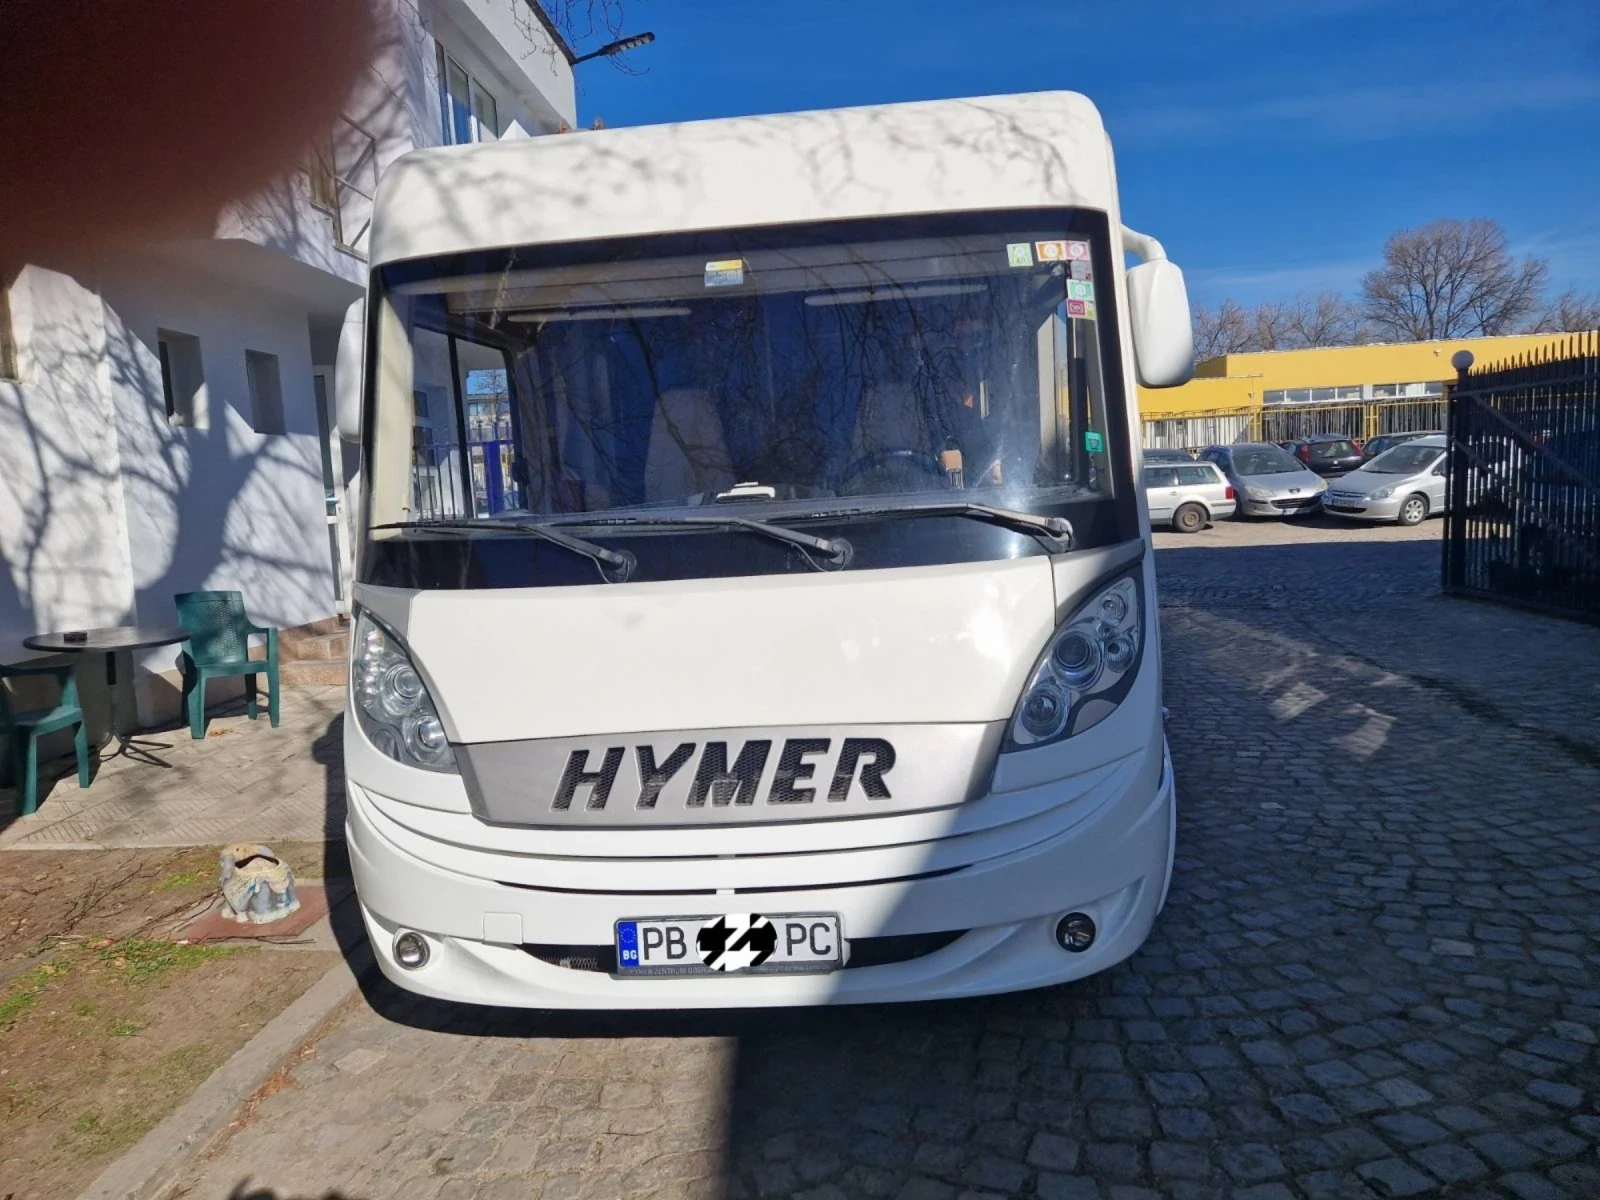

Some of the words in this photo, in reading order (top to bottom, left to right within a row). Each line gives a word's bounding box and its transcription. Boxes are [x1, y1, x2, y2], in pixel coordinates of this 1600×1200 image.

[550, 737, 897, 811] HYMER
[623, 950, 638, 960] BG
[642, 927, 687, 960] PB
[785, 922, 832, 956] PC
